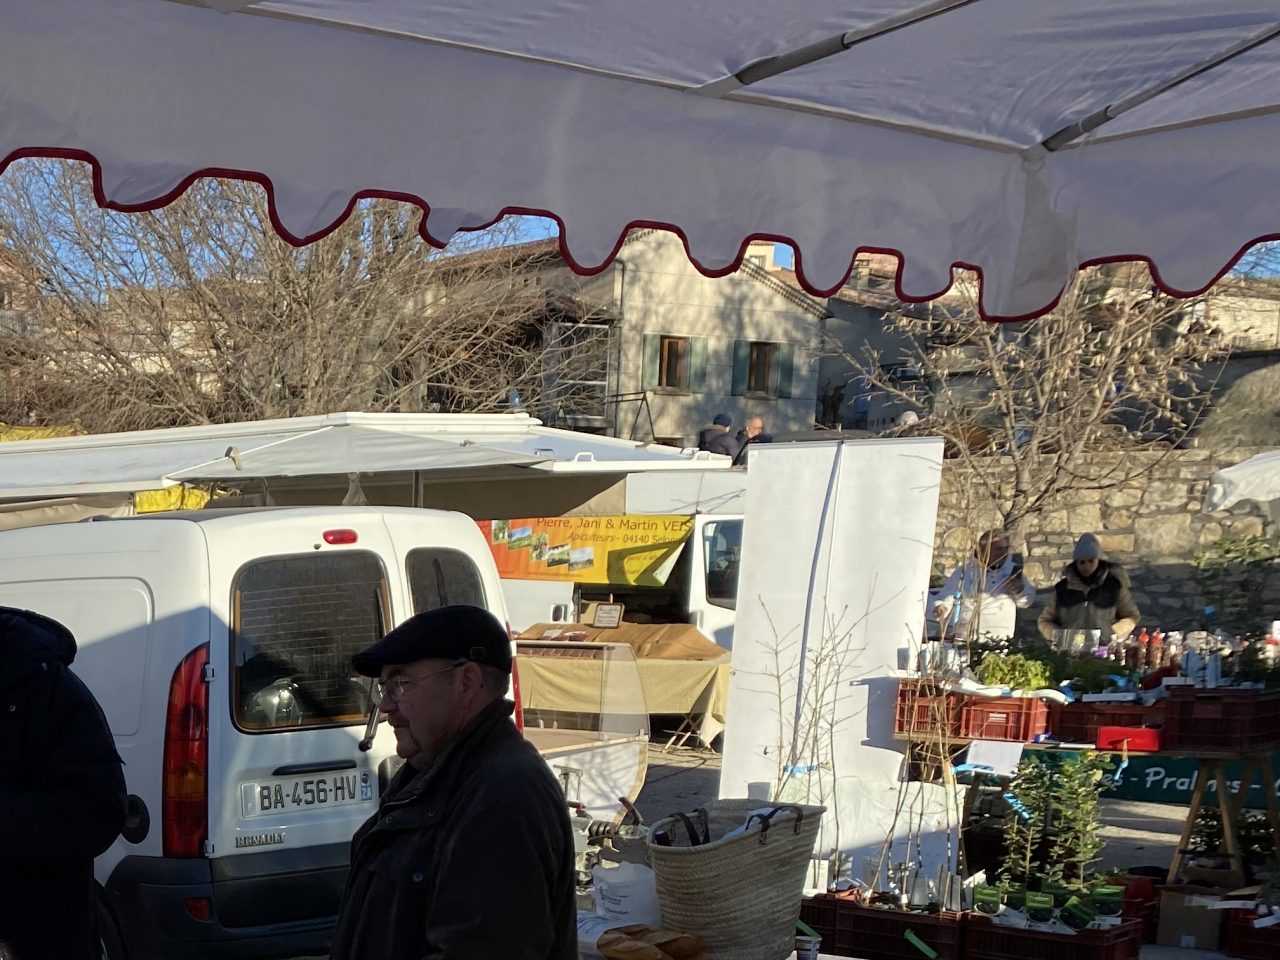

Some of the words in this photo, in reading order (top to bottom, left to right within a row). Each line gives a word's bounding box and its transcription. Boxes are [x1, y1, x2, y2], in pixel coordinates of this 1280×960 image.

[537, 517, 573, 529] Pierre,
[577, 518, 601, 528] Jani
[606, 518, 615, 529] &
[619, 519, 658, 531] Martin
[623, 533, 649, 543] 04140
[1145, 767, 1243, 793] Pralns
[260, 775, 357, 811] BA-456-HV
[361, 787, 372, 799] 2A
